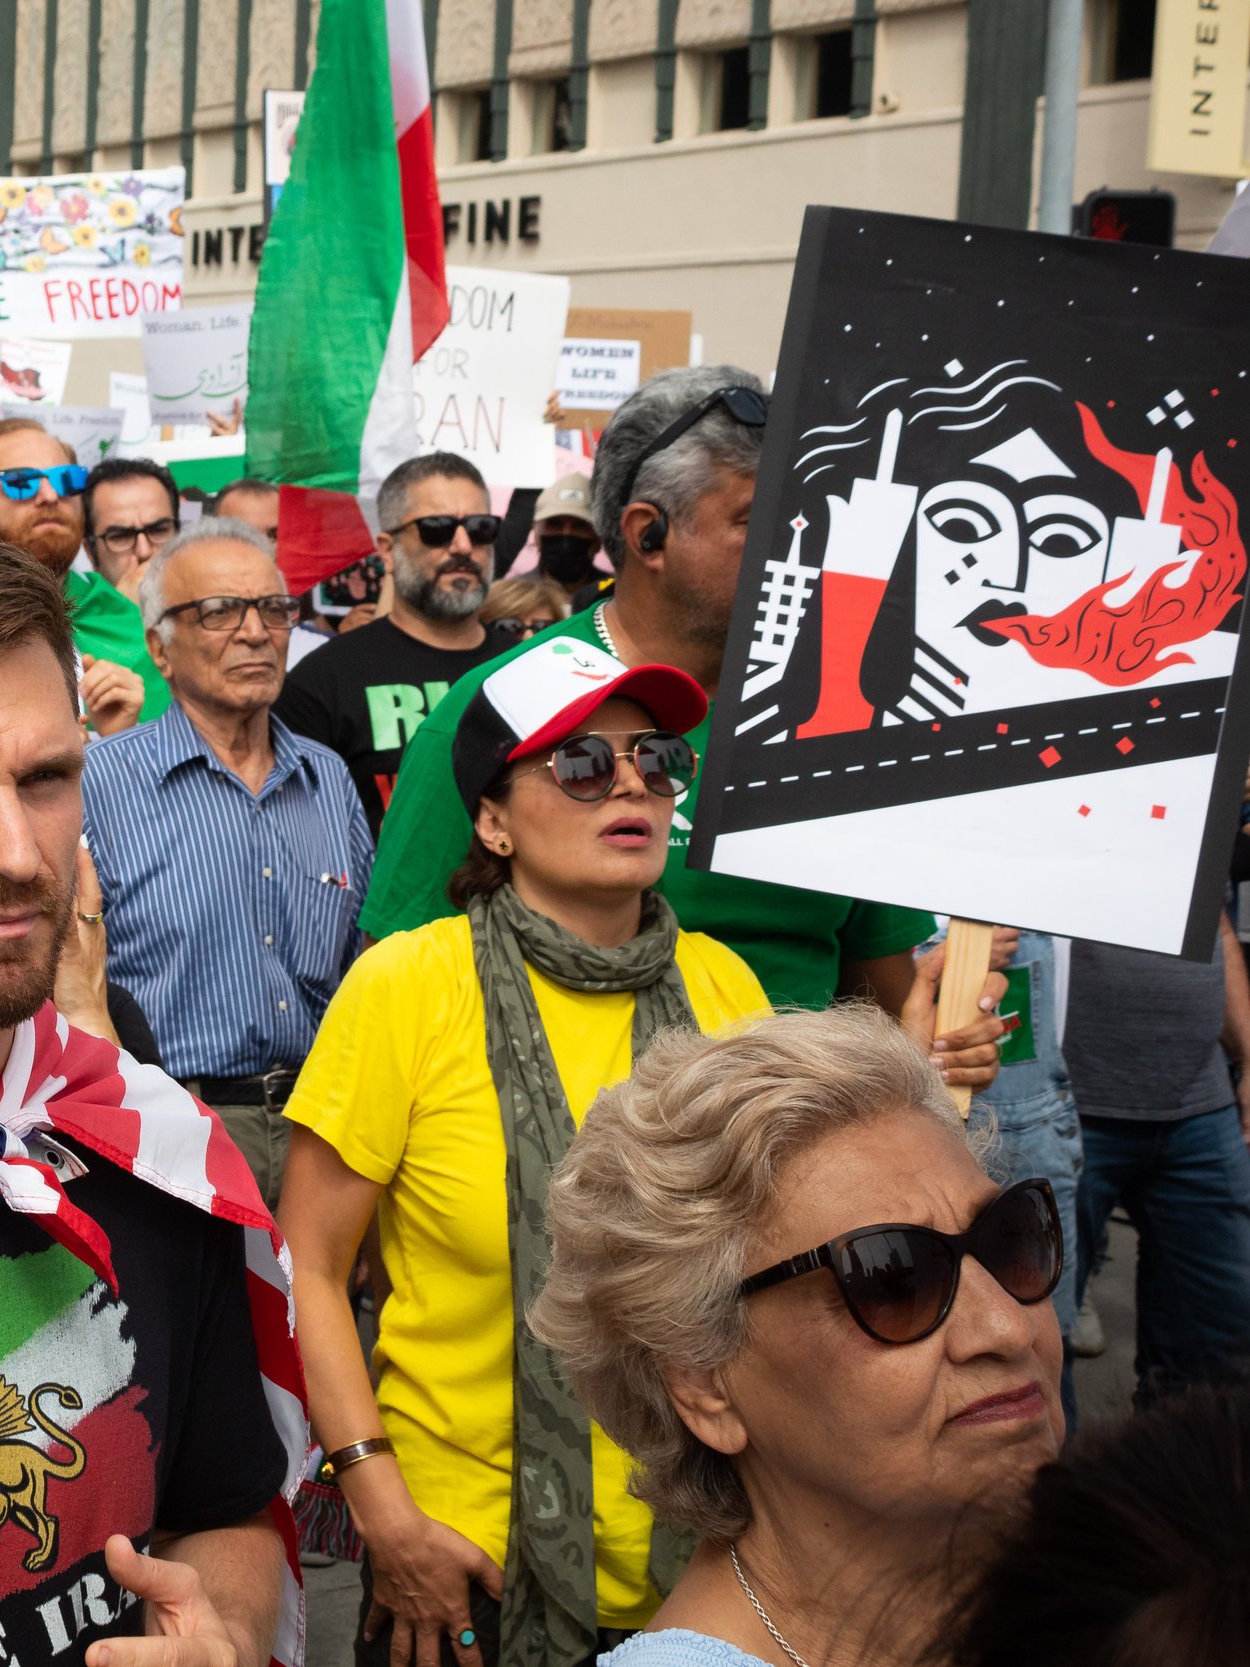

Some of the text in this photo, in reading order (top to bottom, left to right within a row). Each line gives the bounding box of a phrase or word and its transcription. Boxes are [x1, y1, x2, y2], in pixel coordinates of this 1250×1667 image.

[43, 276, 183, 323] FREEDOM
[447, 284, 516, 333] DOM
[570, 367, 617, 380] LIFE
